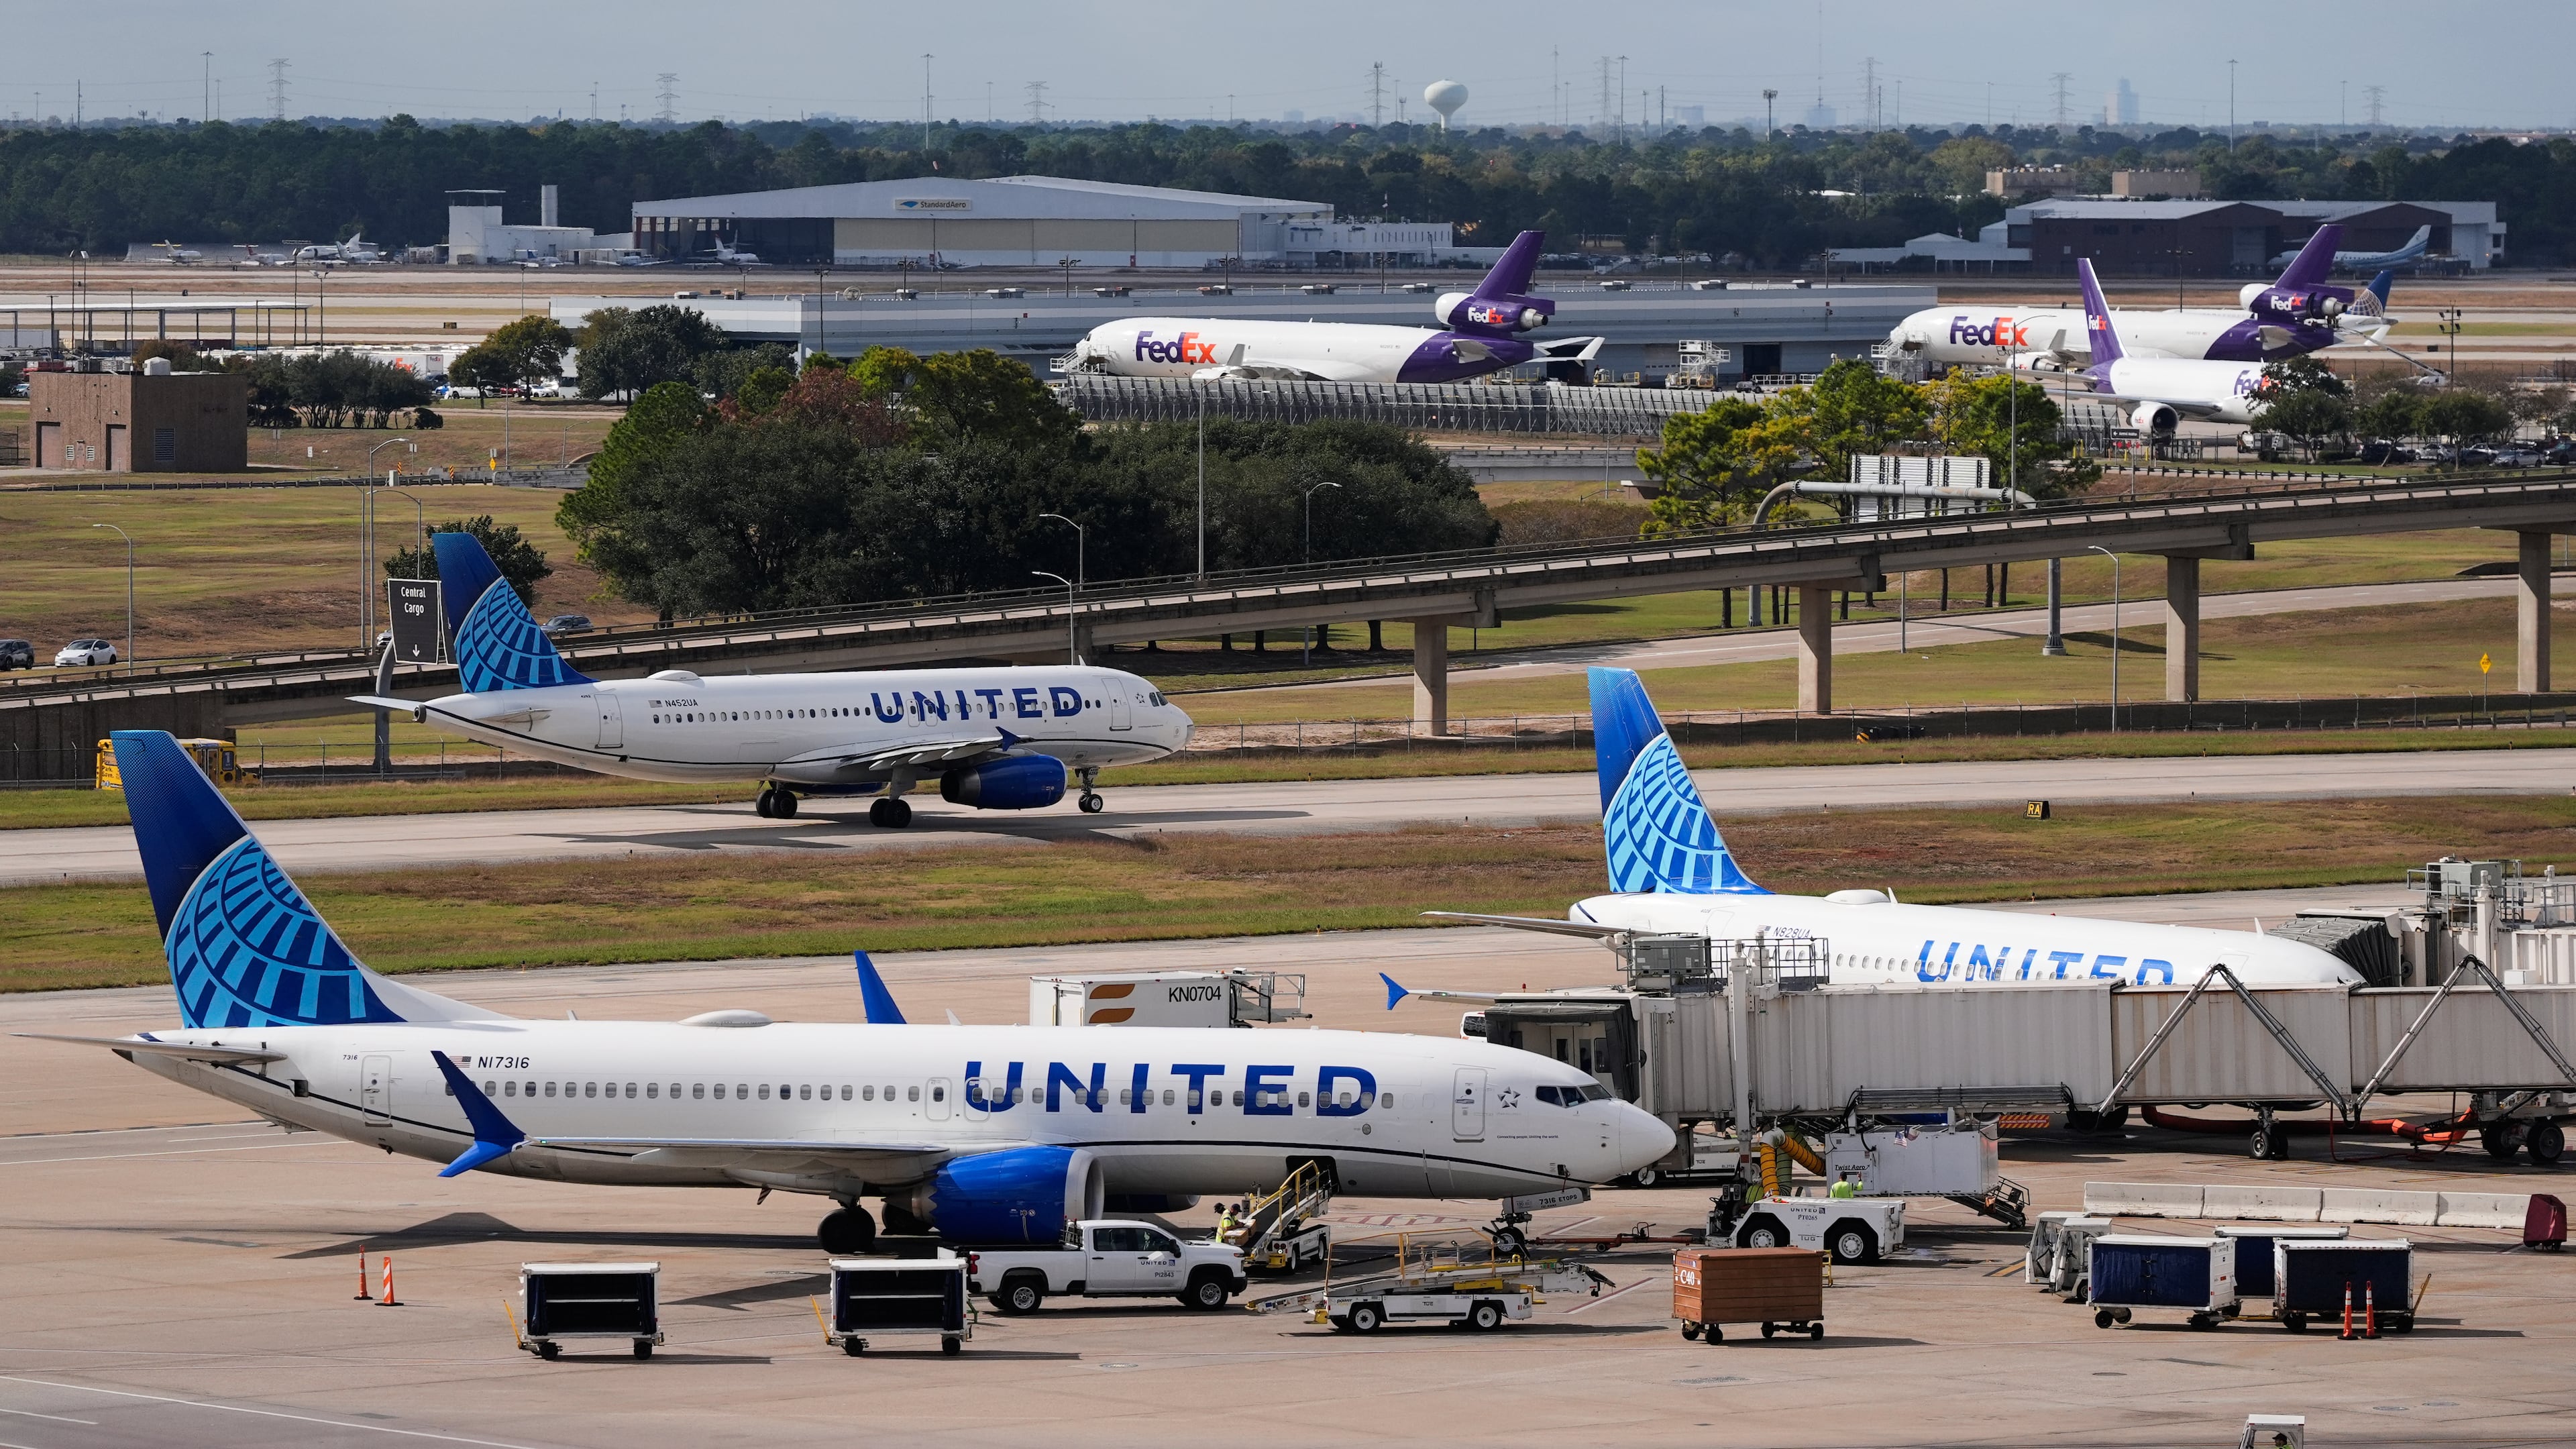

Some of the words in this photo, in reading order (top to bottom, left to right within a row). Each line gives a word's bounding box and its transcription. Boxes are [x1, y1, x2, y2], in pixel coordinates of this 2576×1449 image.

[1468, 307, 1504, 324] FedEx
[2088, 314, 2106, 330] FedEx
[1949, 316, 2029, 346] FedEx
[1136, 331, 1218, 364] FedEx
[401, 586, 426, 598] Central
[404, 602, 424, 616] Cargo
[665, 699, 698, 707] N452UA
[871, 687, 1082, 723] UNITED
[2029, 804, 2040, 815] RA
[1774, 926, 1811, 939] N828UA
[1917, 940, 2174, 985] UNITED
[1169, 986, 1221, 1002] KN0704
[478, 1057, 530, 1069] N17316
[965, 1061, 1377, 1116] UNITED
